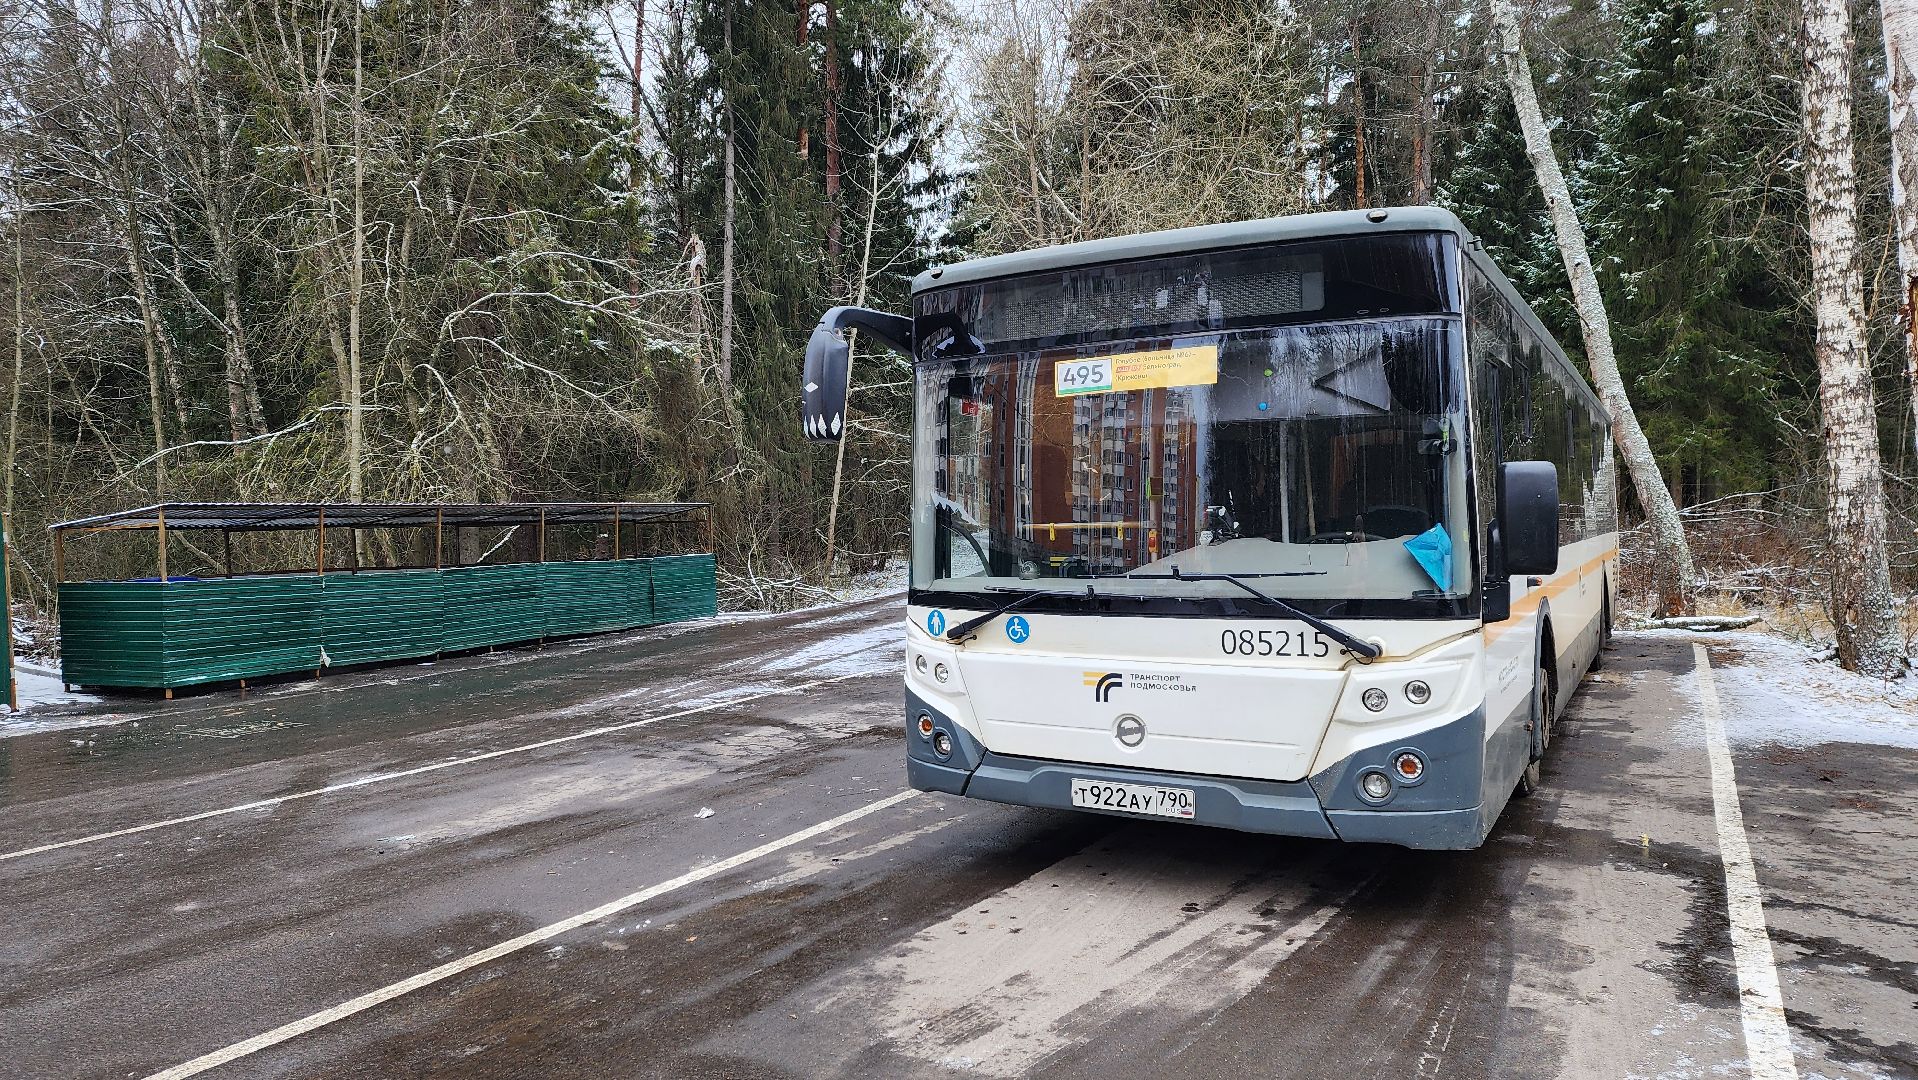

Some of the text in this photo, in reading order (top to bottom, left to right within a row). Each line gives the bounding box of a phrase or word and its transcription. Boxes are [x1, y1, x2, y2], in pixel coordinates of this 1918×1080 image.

[1063, 364, 1104, 386] 495
[1221, 629, 1329, 658] 085215
[1130, 673, 1181, 682] ТРАНСПОРТ
[1130, 682, 1197, 692] ПОДМОСКОВЬЯ
[1157, 790, 1188, 809] 790
